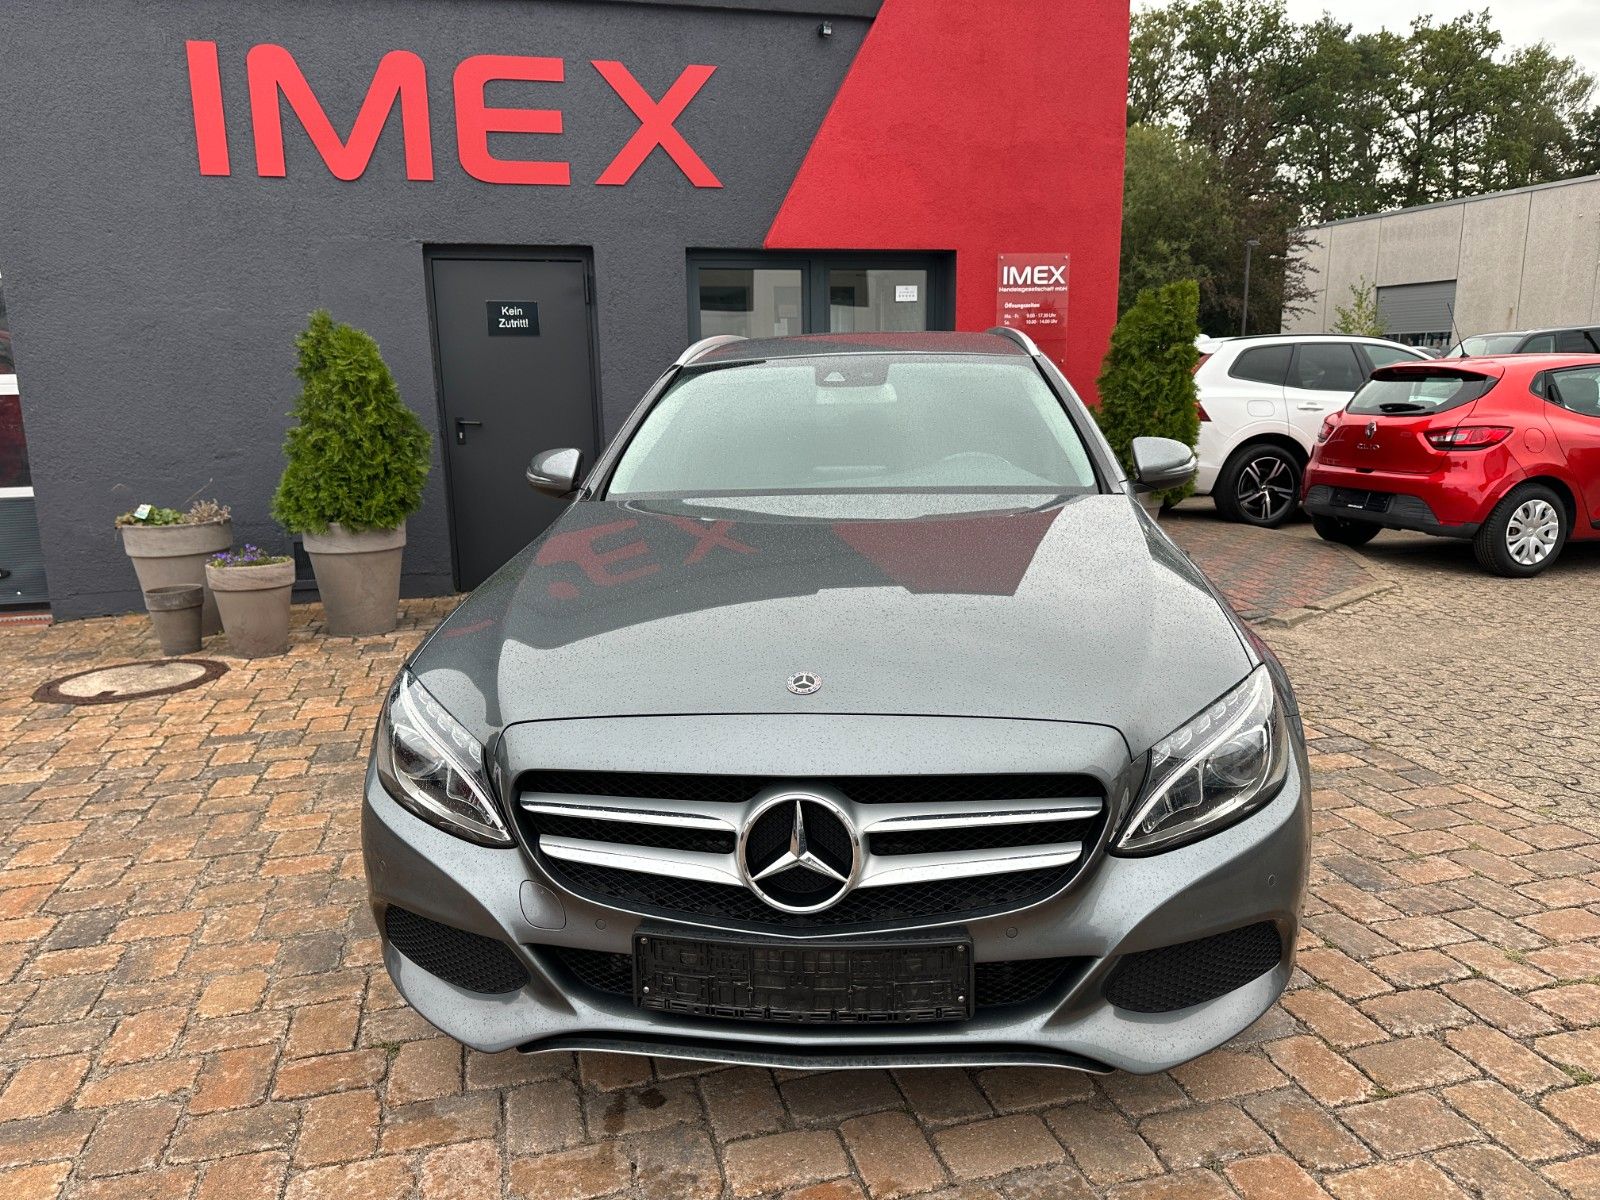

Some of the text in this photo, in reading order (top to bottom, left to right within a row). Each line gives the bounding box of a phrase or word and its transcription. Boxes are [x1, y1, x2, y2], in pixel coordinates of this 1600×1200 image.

[185, 40, 723, 188] IMEX
[1003, 265, 1066, 285] IMEX
[501, 306, 523, 316] Kein
[498, 318, 529, 328] Zutritt!
